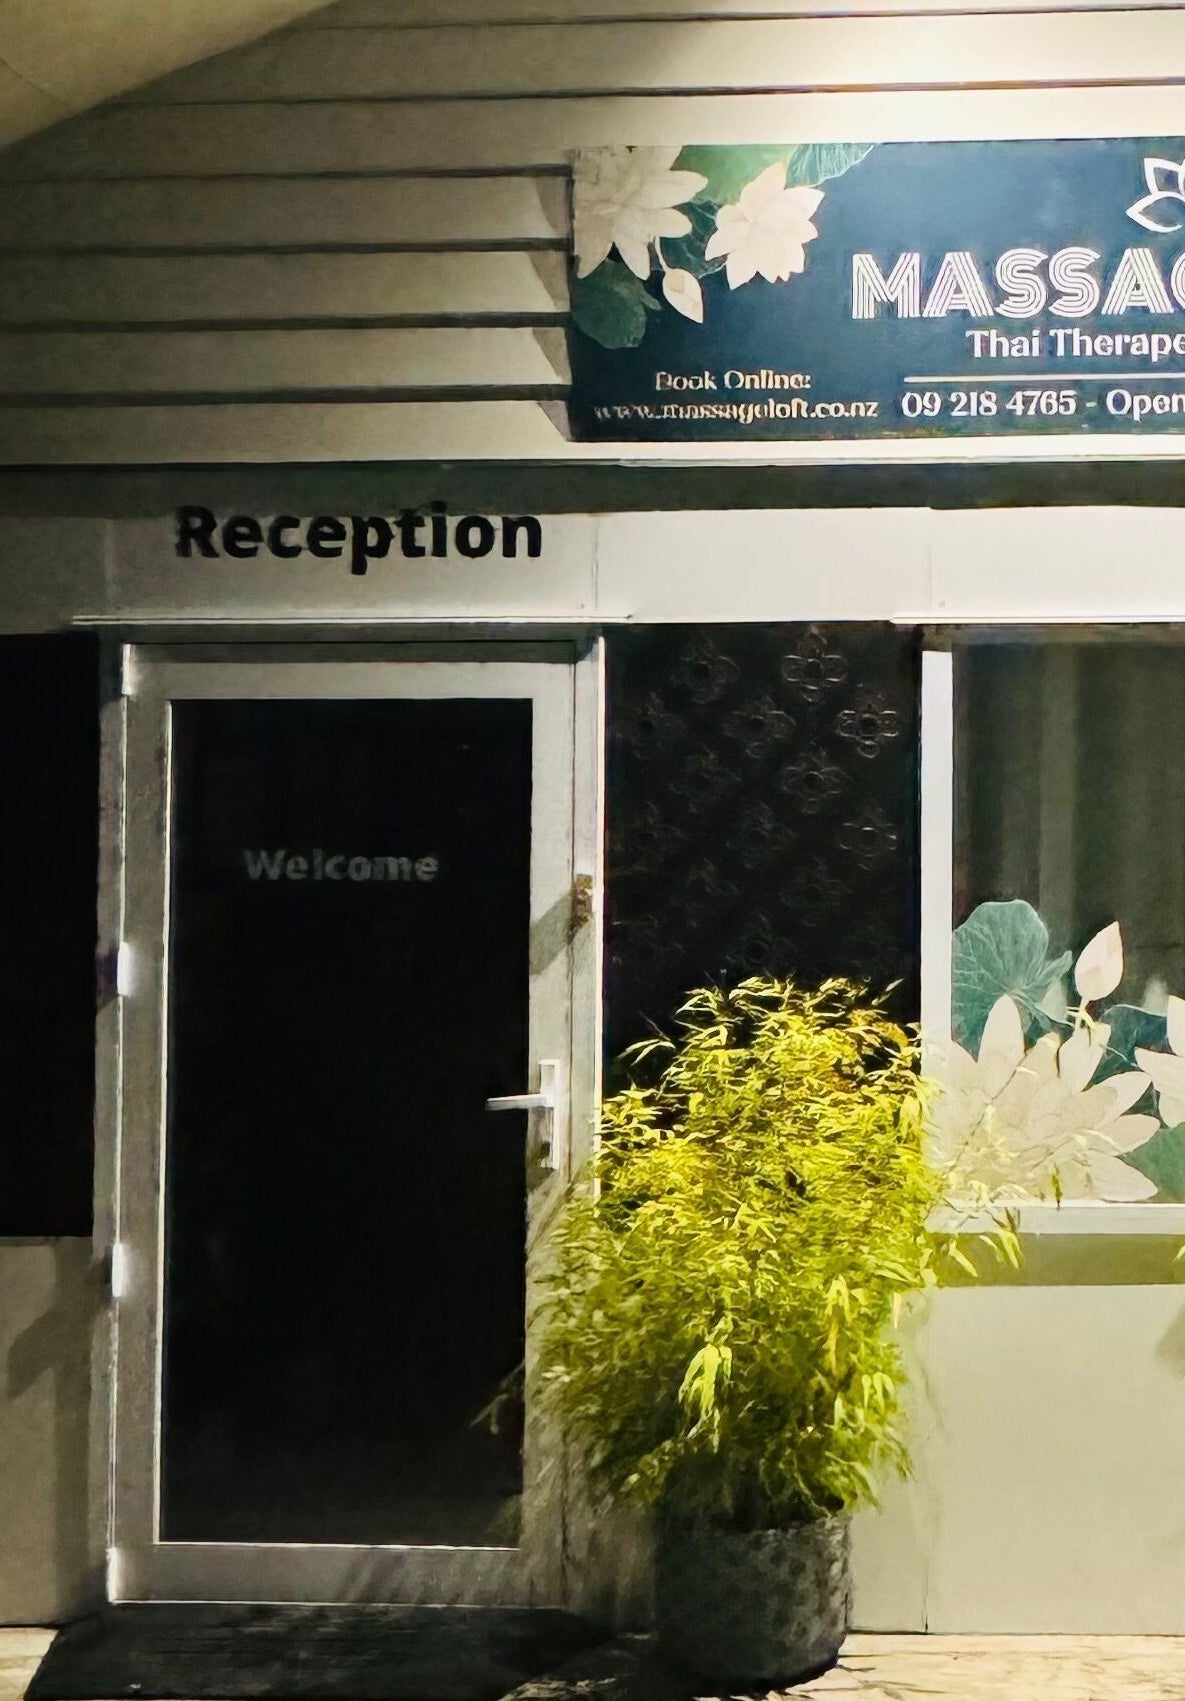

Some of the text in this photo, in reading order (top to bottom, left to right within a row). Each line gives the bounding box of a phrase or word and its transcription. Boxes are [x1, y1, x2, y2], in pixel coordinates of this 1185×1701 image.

[966, 328, 1041, 358] Thai
[655, 370, 811, 392] Book Online:
[902, 392, 941, 417] 09
[950, 391, 996, 416] 218
[1006, 390, 1077, 415] 4765
[175, 500, 542, 576] Reception
[243, 848, 440, 882] Welcome
